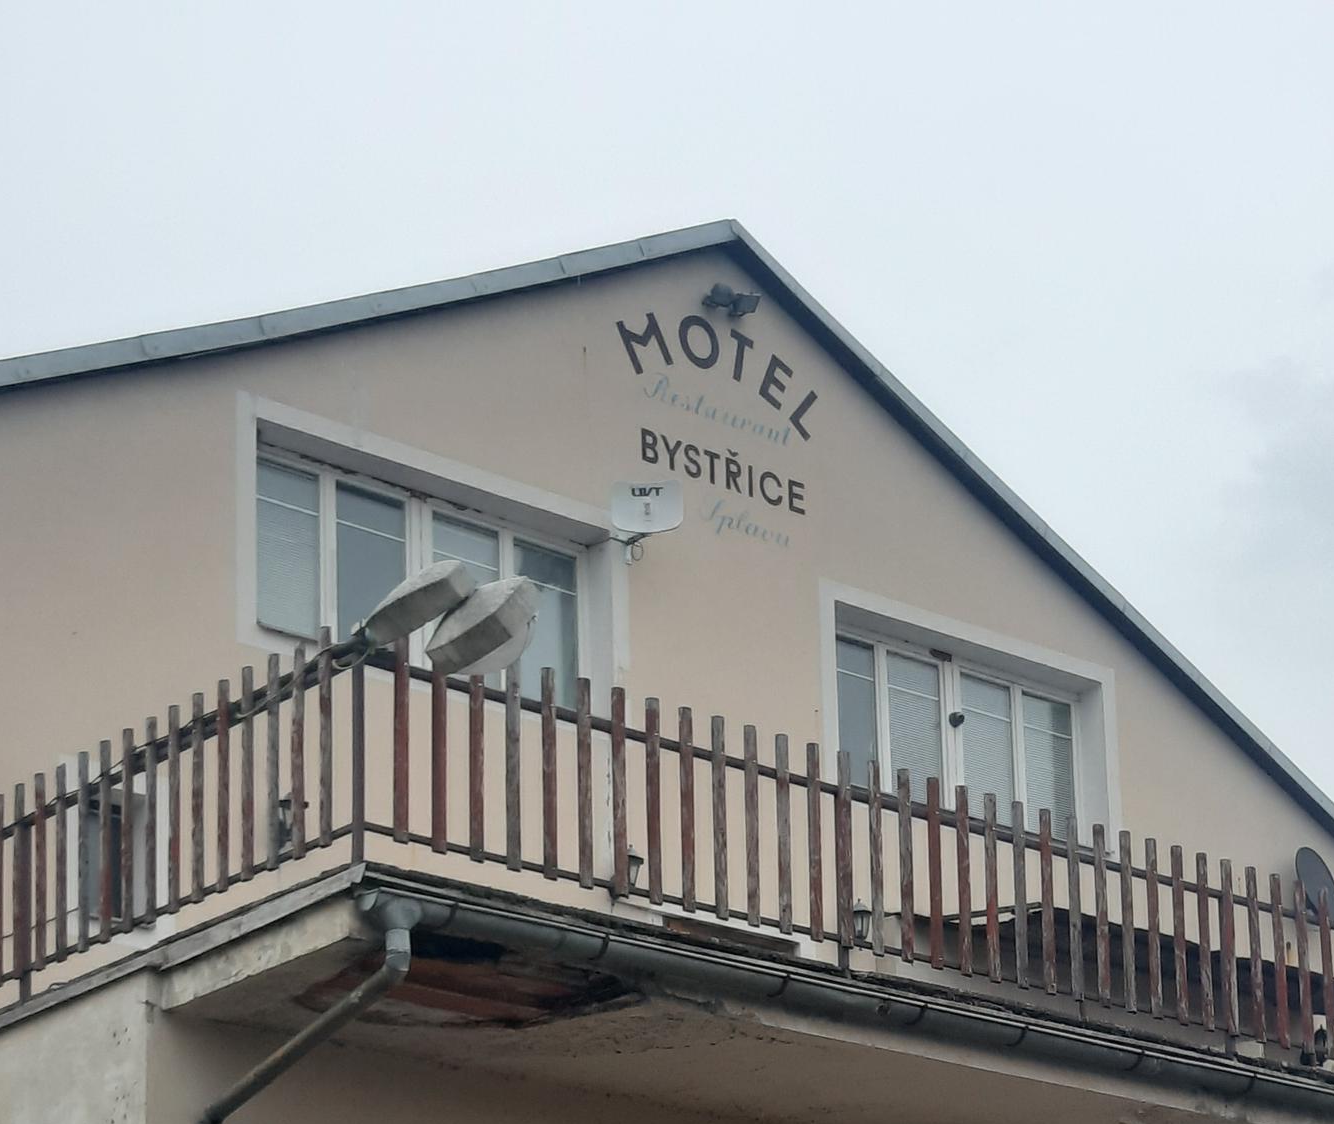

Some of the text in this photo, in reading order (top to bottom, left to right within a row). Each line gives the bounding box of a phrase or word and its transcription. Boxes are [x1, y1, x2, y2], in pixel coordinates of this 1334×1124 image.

[616, 312, 818, 442] MOTEL
[643, 372, 791, 447] Restaurant
[640, 427, 806, 516] BYSTŘICE
